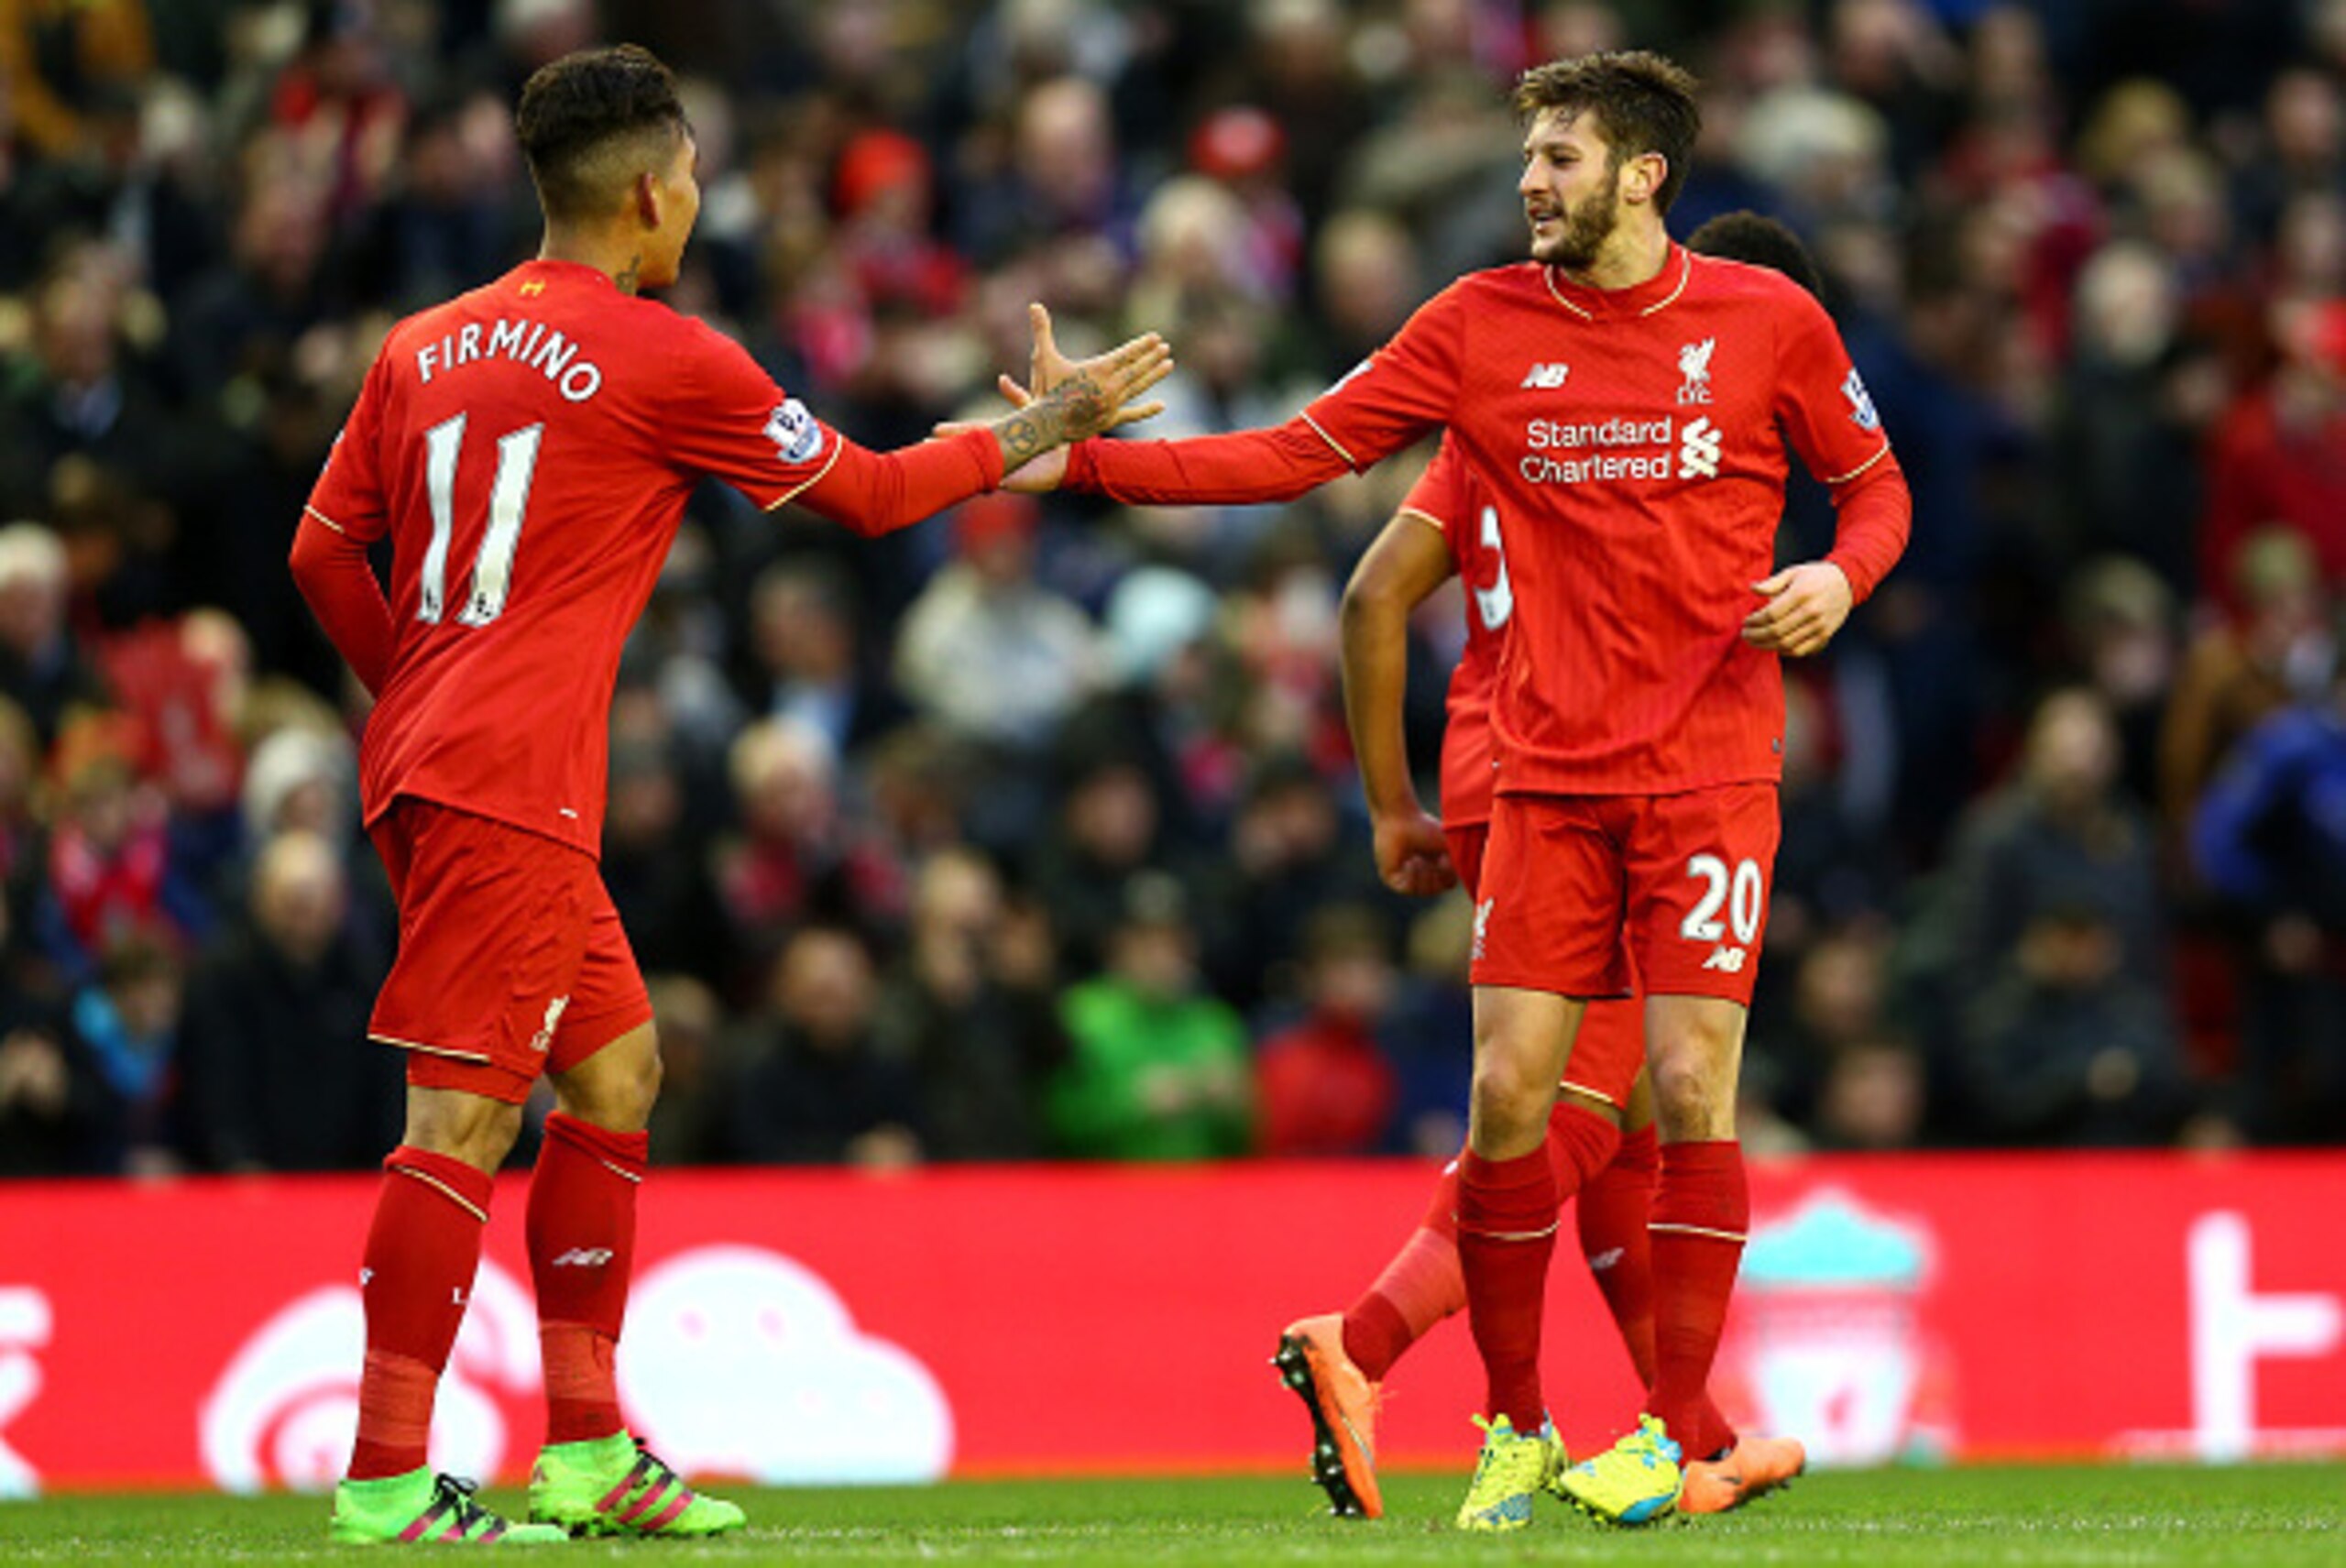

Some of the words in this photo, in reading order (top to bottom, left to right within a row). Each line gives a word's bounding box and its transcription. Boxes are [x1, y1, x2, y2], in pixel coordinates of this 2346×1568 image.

[416, 318, 602, 402] FIRMINO
[1519, 454, 1672, 483] Chartered
[1527, 416, 1672, 449] Standard
[415, 411, 545, 629] 11
[1679, 852, 1762, 945] 20
